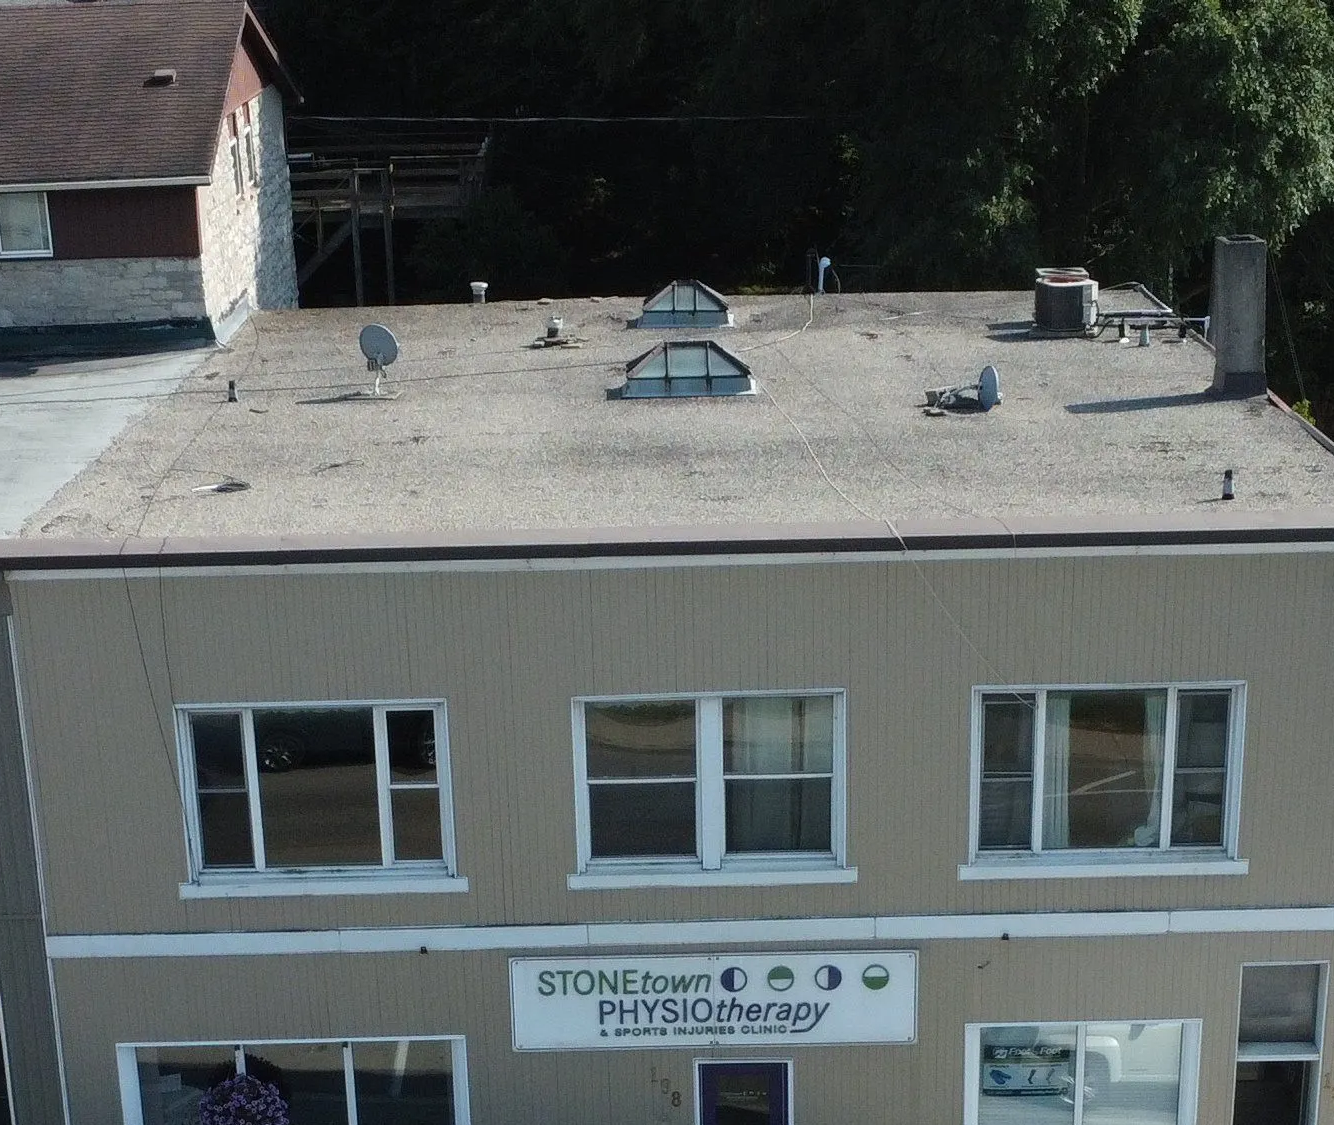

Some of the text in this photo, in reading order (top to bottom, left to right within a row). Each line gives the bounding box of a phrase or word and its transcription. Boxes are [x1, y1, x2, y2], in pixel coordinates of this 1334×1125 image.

[537, 969, 713, 997] STONEtown
[599, 997, 831, 1034] PHYSIOtherapy
[600, 1024, 788, 1038] & SPORTS INJURIES CLINIC
